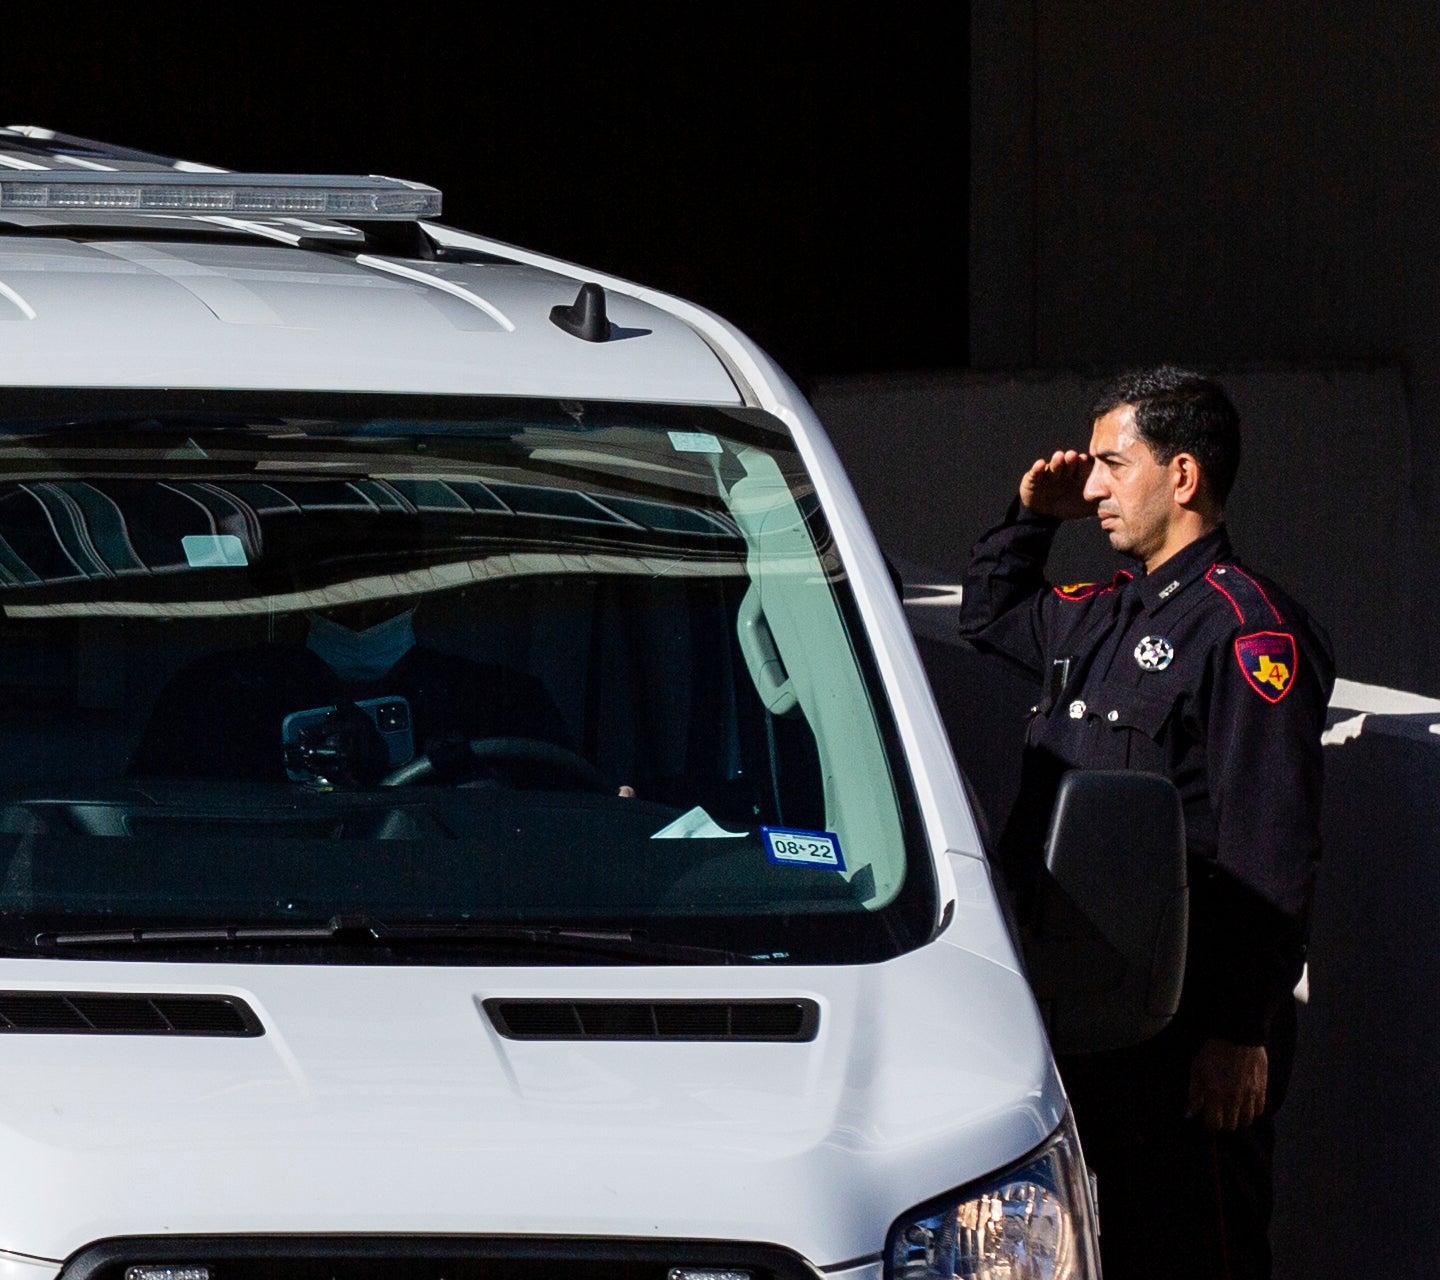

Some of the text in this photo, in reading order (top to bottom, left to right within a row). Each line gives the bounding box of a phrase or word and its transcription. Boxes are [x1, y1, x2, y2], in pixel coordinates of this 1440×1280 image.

[1268, 664, 1283, 682] 4
[775, 840, 833, 859] 08 22
